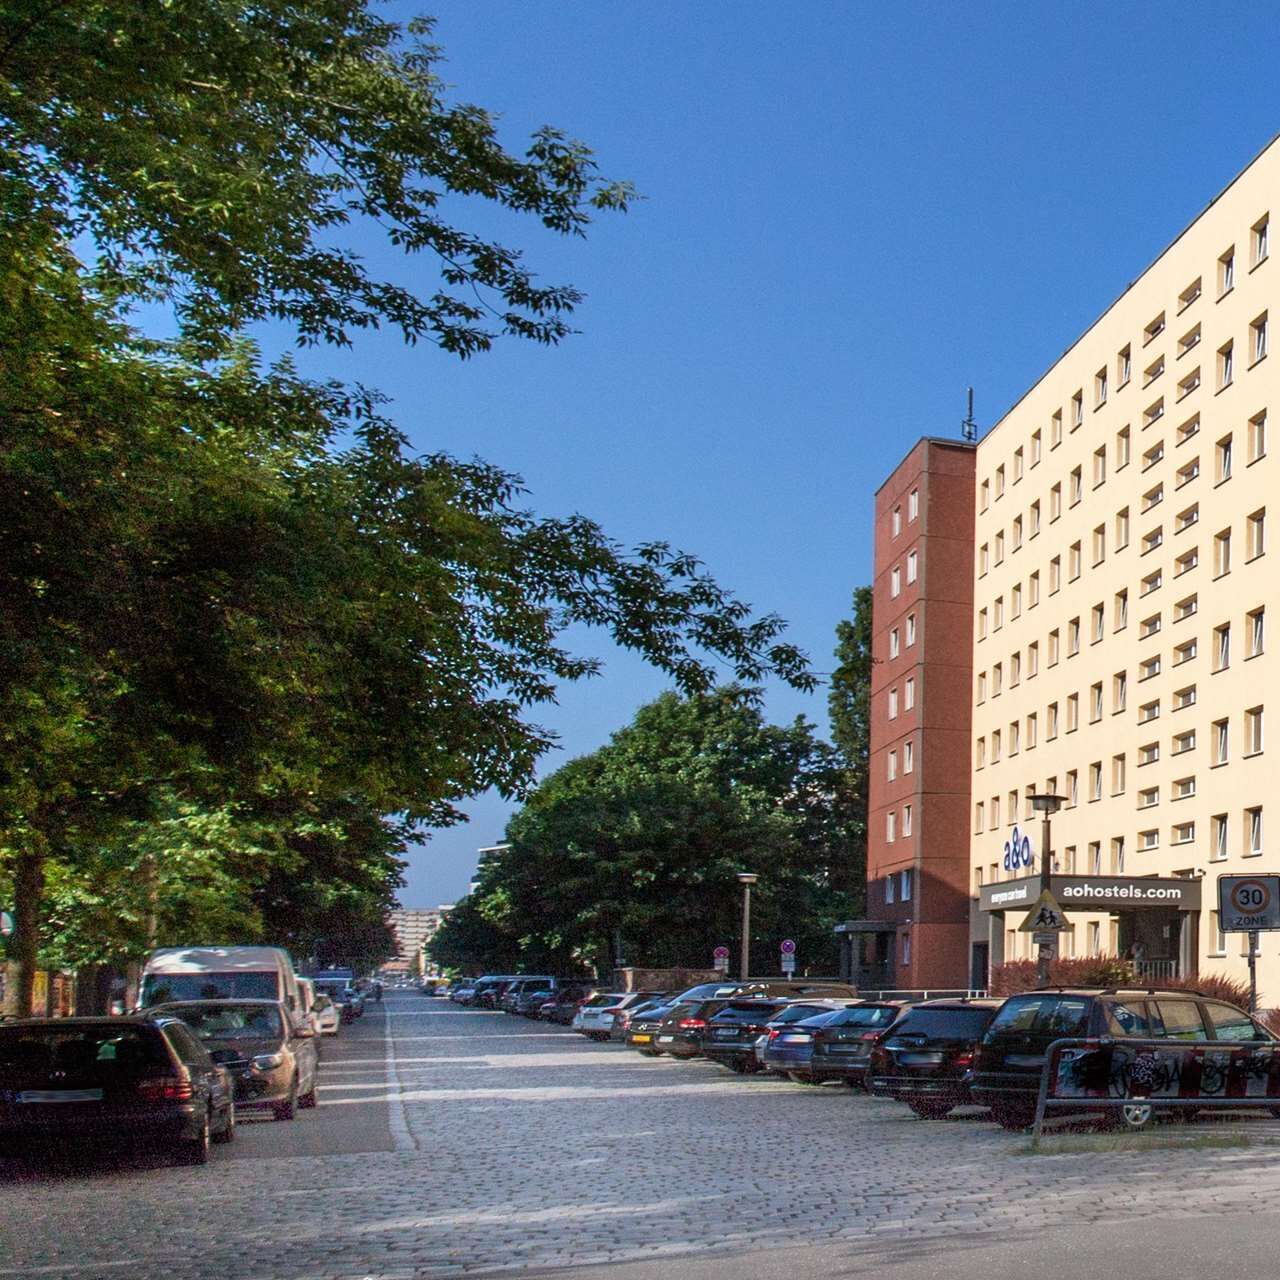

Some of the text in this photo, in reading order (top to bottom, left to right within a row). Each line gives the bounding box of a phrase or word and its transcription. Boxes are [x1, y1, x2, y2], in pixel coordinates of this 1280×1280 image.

[1004, 826, 1031, 871] a&o
[1063, 884, 1182, 898] aohostels.com
[1239, 889, 1263, 906] 30
[1236, 915, 1267, 926] ZONE
